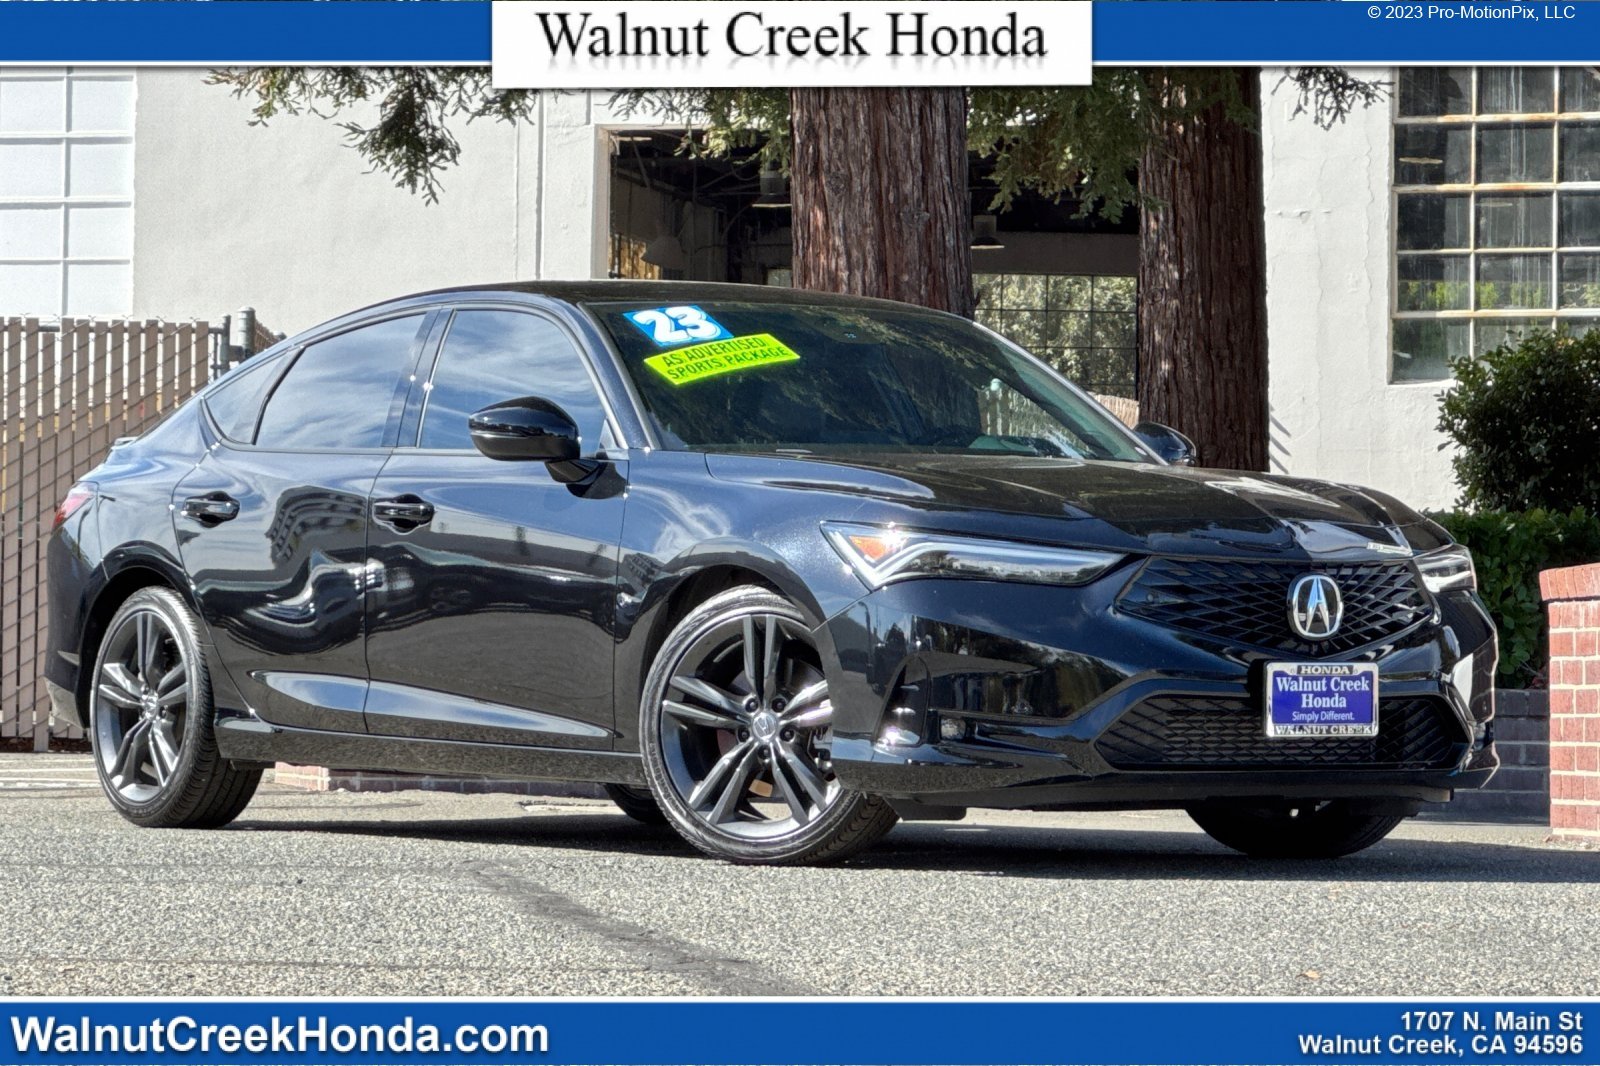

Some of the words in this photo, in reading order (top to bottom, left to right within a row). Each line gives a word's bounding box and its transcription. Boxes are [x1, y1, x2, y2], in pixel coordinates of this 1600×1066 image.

[632, 305, 721, 343] 23
[685, 336, 768, 362] ADVERTISED
[725, 346, 789, 366] PACKAGE
[1300, 665, 1350, 675] HONDA
[1276, 676, 1327, 692] Walnut
[1330, 676, 1370, 692] Creek
[1301, 692, 1347, 708] Honda
[1292, 711, 1319, 722] Simply
[1320, 710, 1355, 721] Different.
[1275, 725, 1329, 735] WALNUT
[1330, 725, 1372, 735] CREEK
